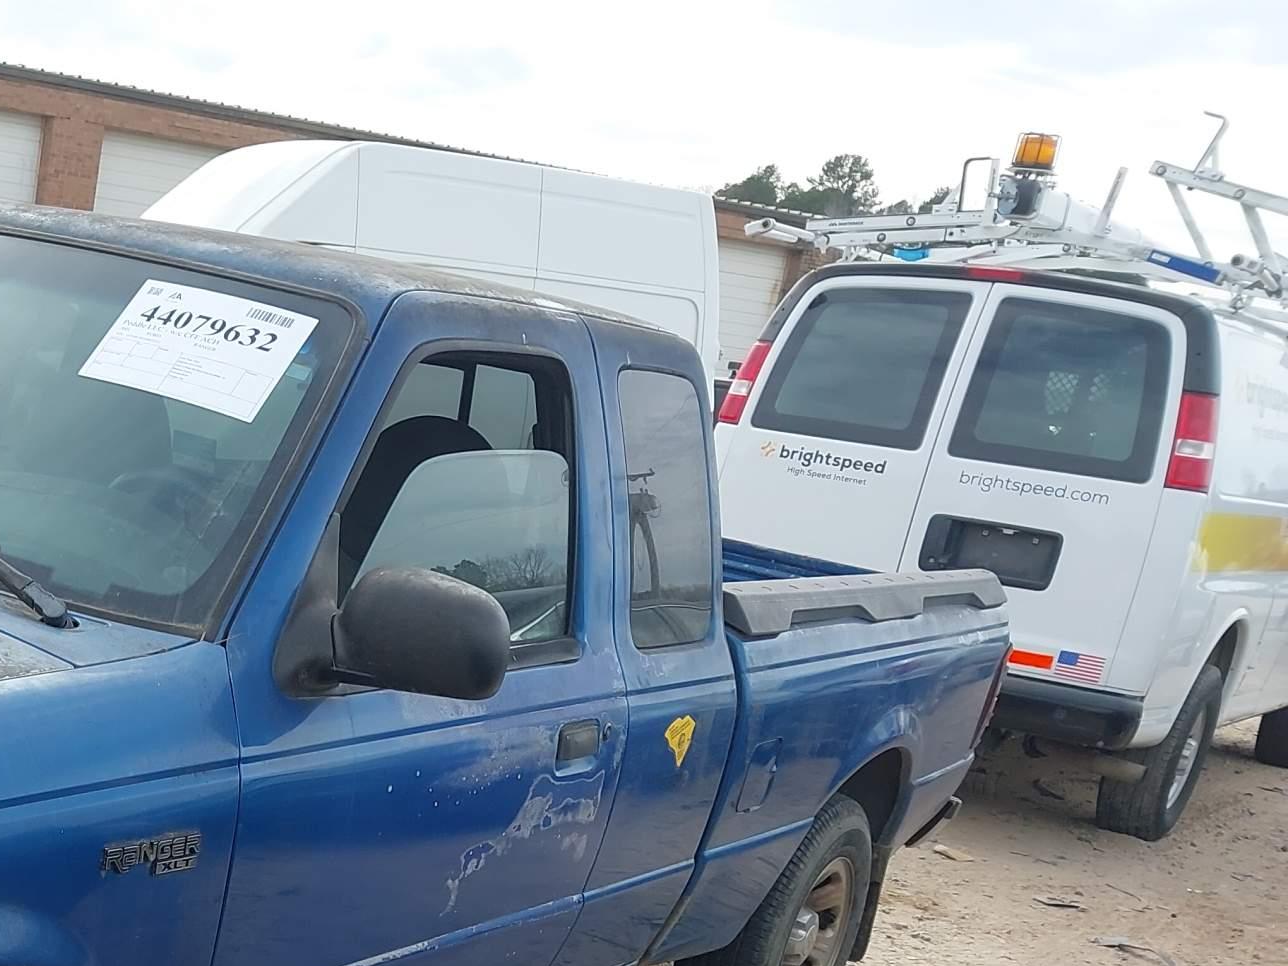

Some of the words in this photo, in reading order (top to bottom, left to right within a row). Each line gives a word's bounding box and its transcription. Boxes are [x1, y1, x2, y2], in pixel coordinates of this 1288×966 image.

[140, 305, 278, 352] 44079632
[779, 445, 887, 474] brightspeed
[787, 466, 805, 477] High
[806, 469, 832, 480] Speed
[833, 473, 867, 486] Internet
[959, 470, 1110, 504] brightspeed.com
[103, 833, 201, 874] RANGER
[161, 858, 195, 873] XLT
